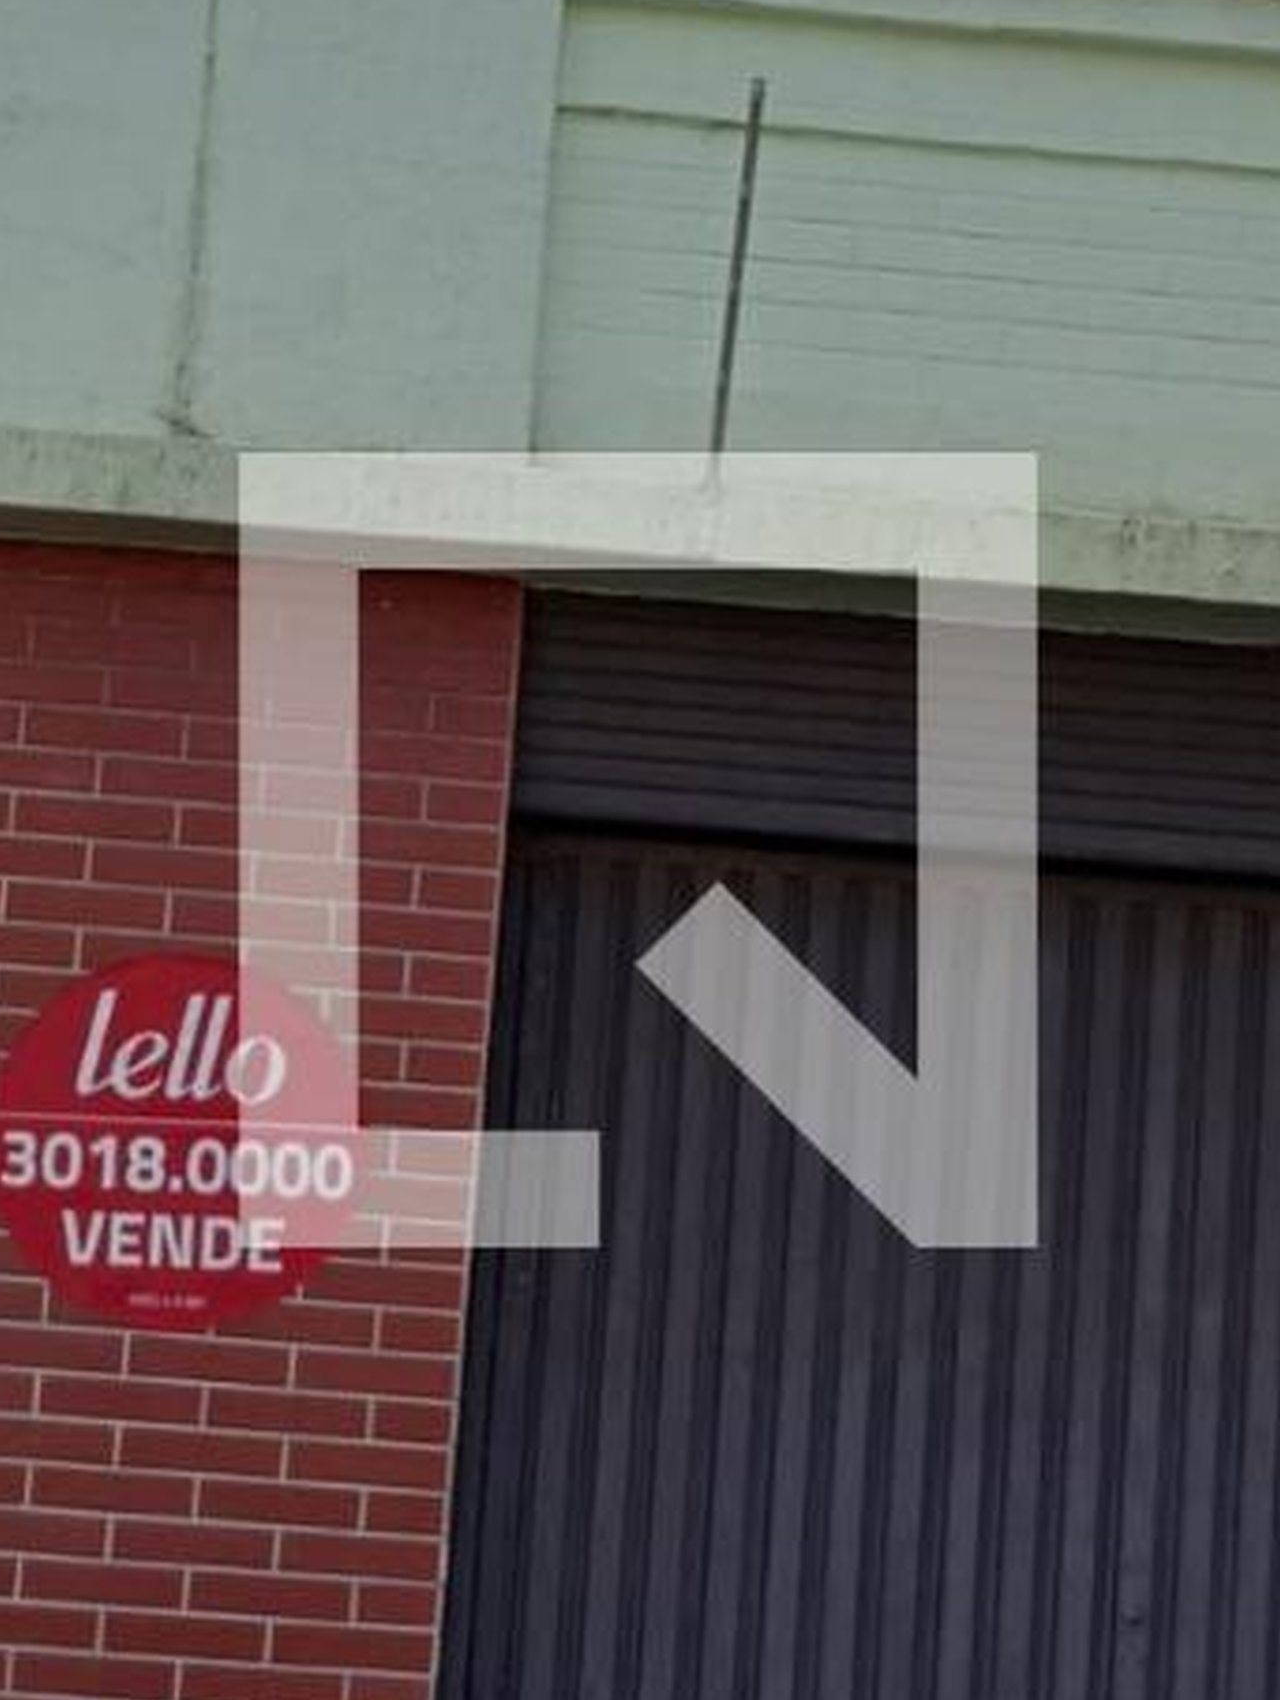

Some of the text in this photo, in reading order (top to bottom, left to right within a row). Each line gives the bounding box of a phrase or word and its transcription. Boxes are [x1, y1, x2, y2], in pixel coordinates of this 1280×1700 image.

[75, 987, 287, 1106] lello
[0, 1130, 354, 1200] 3018.0000
[60, 1208, 287, 1274] VENDE
